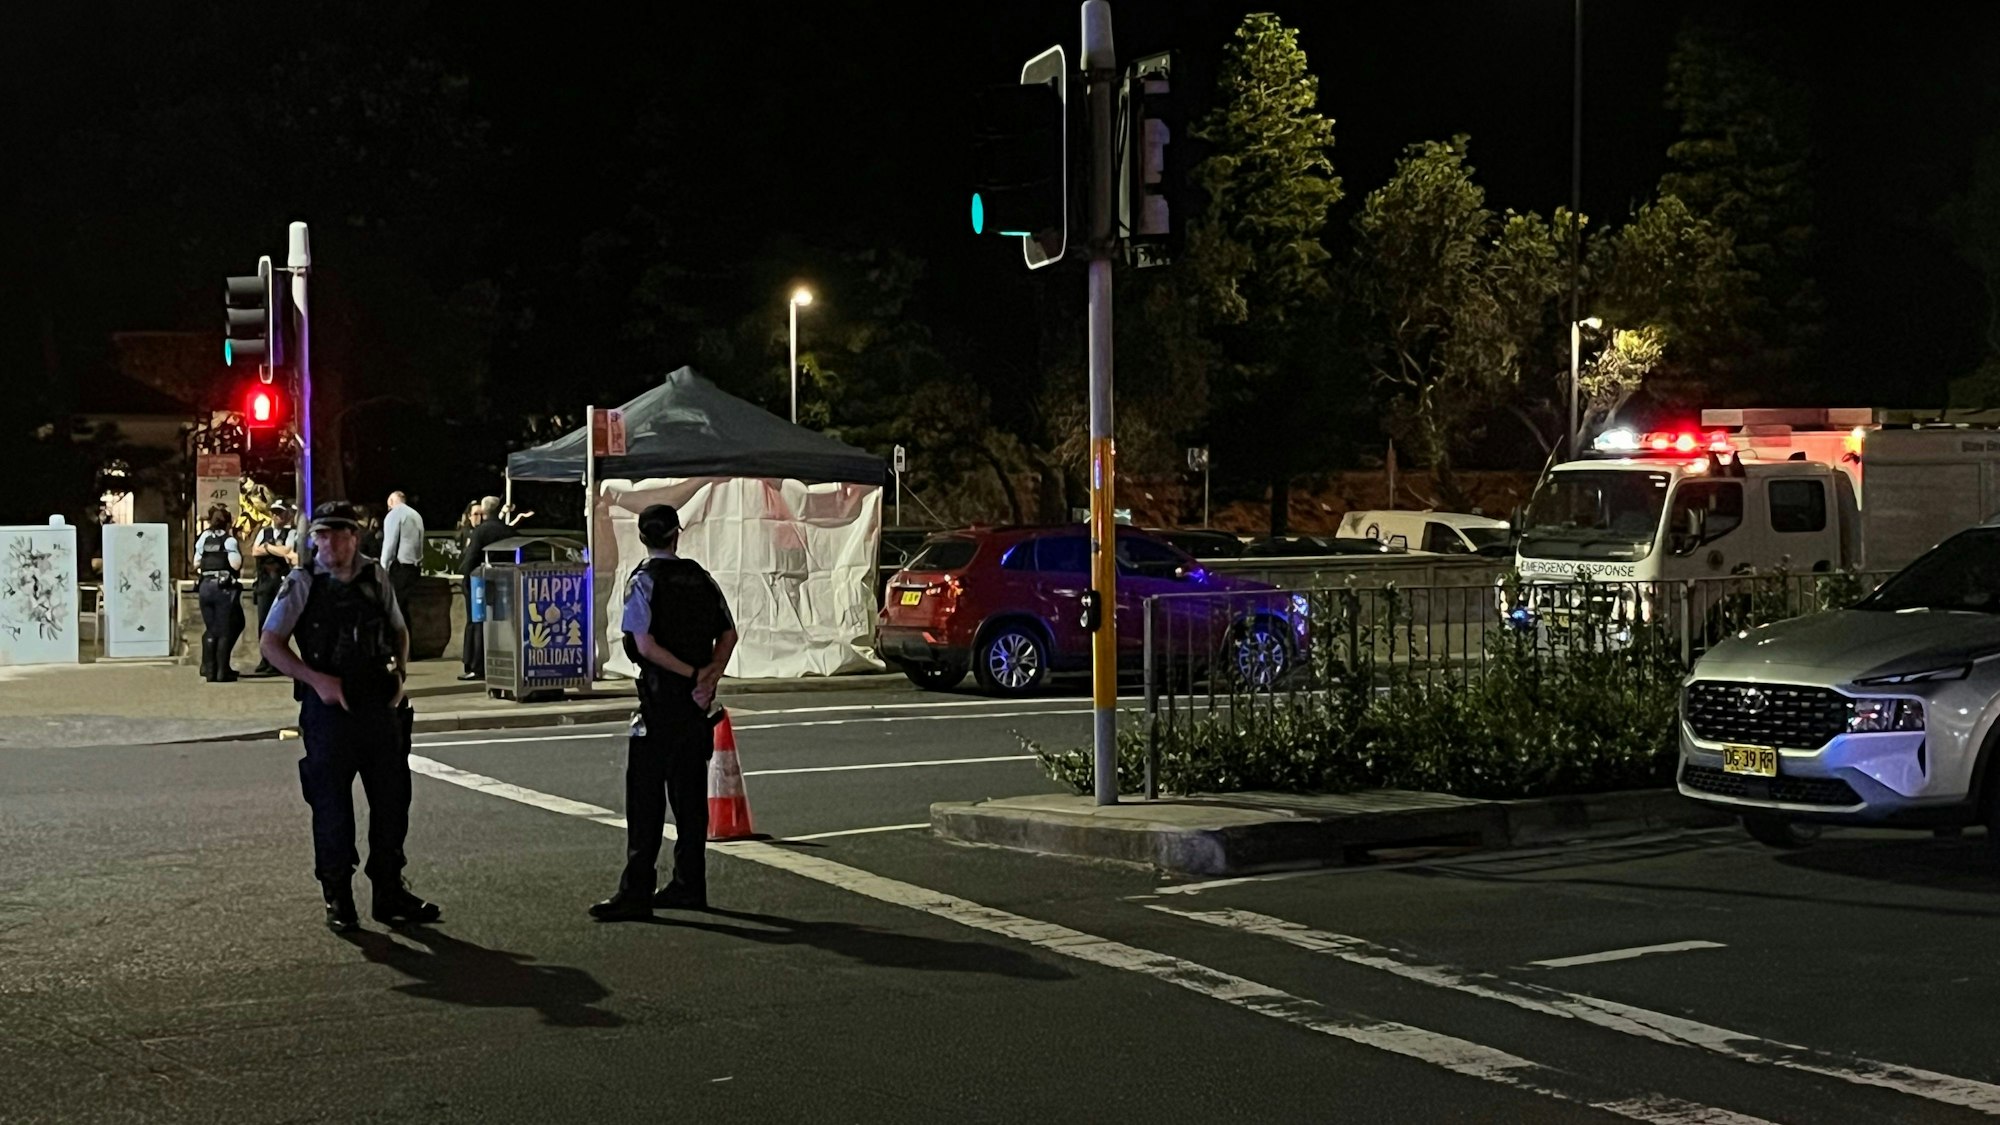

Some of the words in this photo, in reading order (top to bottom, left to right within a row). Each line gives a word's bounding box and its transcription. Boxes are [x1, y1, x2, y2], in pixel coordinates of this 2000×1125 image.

[210, 489, 228, 499] 4P
[1521, 561, 1576, 574] EMERGENCY
[528, 577, 582, 602] HAPPY
[528, 647, 583, 667] HOLIDAYS
